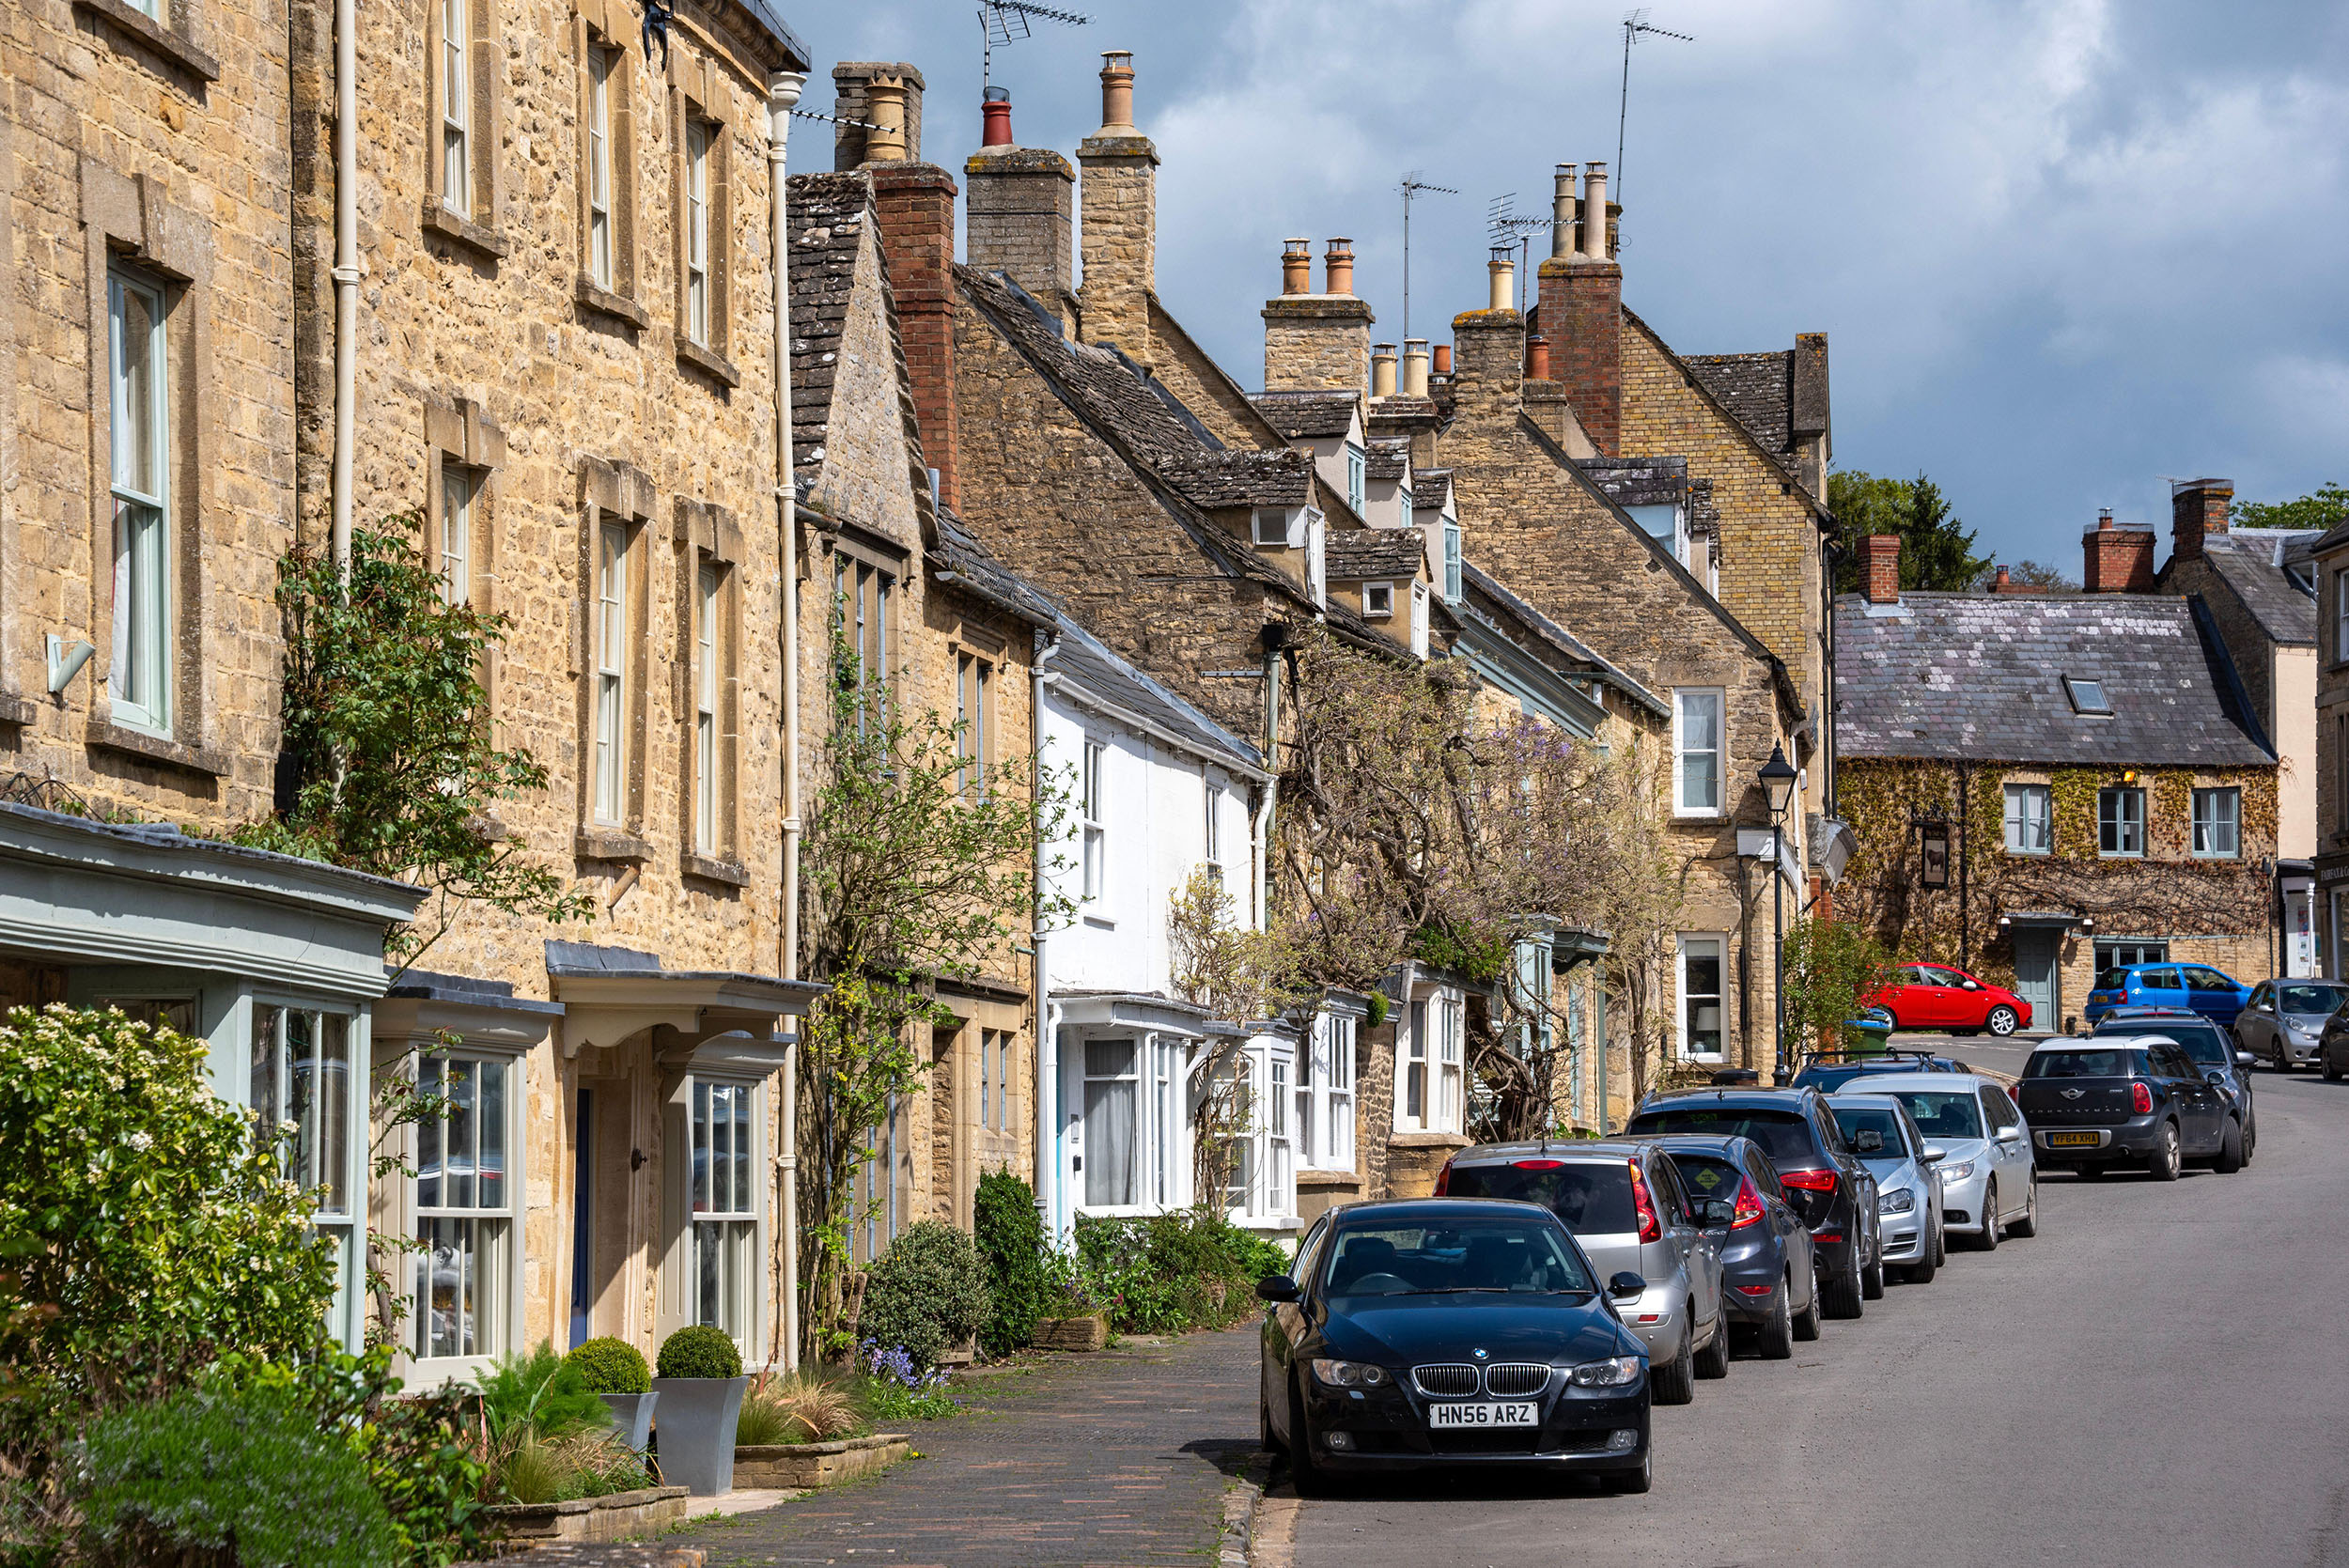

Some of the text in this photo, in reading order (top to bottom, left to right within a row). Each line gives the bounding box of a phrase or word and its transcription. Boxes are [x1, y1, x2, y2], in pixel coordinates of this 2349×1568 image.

[2054, 1134, 2097, 1143] YF64 XHA
[1439, 1405, 1531, 1424] HN56 ARZ
